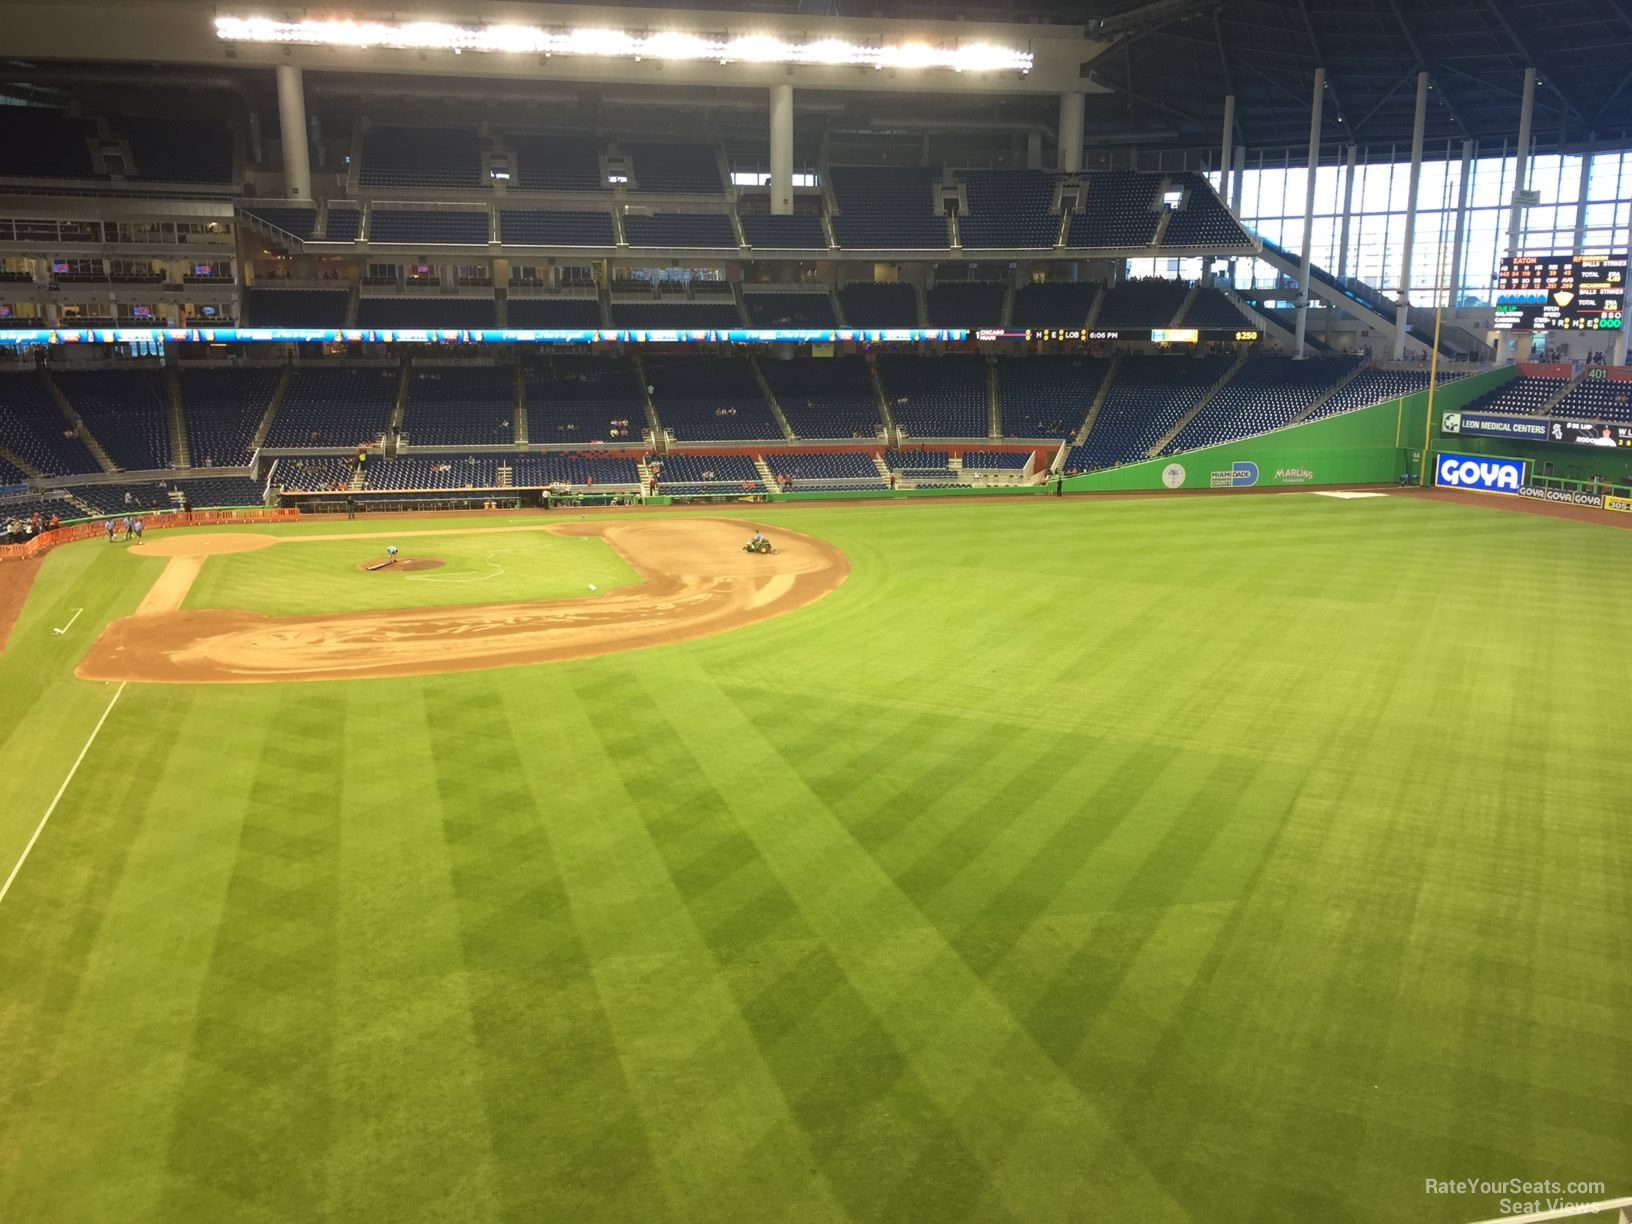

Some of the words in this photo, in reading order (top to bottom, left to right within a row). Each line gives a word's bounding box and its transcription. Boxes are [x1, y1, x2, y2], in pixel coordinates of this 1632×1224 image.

[1236, 331, 1257, 341] $250
[1589, 368, 1607, 379] 401
[1462, 419, 1478, 429] LEON
[1479, 421, 1512, 431] MEDICAL
[1513, 423, 1546, 434] CENTERS
[1275, 468, 1312, 479] MARLINS
[1441, 459, 1518, 488] GOYA
[1519, 487, 1545, 499] GOYA
[1546, 490, 1572, 503] GOYA
[1575, 494, 1600, 505] GOYA
